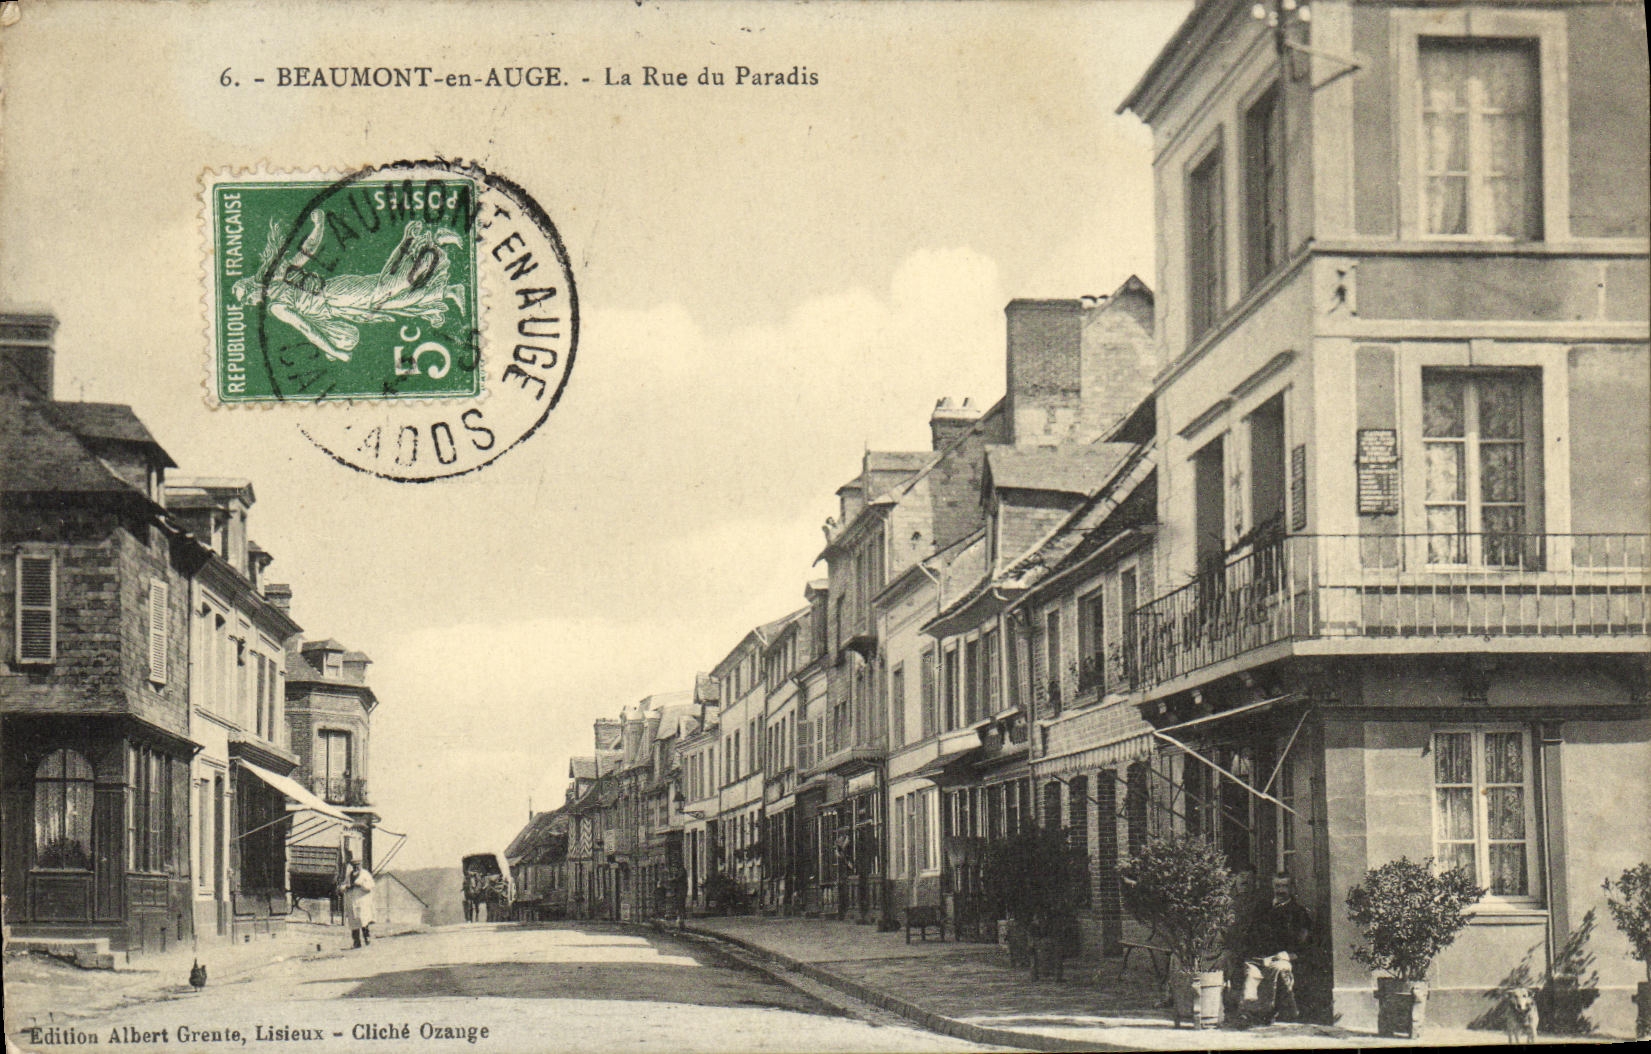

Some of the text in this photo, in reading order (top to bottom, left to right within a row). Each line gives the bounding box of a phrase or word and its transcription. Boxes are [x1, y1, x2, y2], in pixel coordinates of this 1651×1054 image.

[223, 191, 244, 276] FRANÇAISE
[492, 232, 540, 281] EN
[502, 286, 560, 401] AUGE
